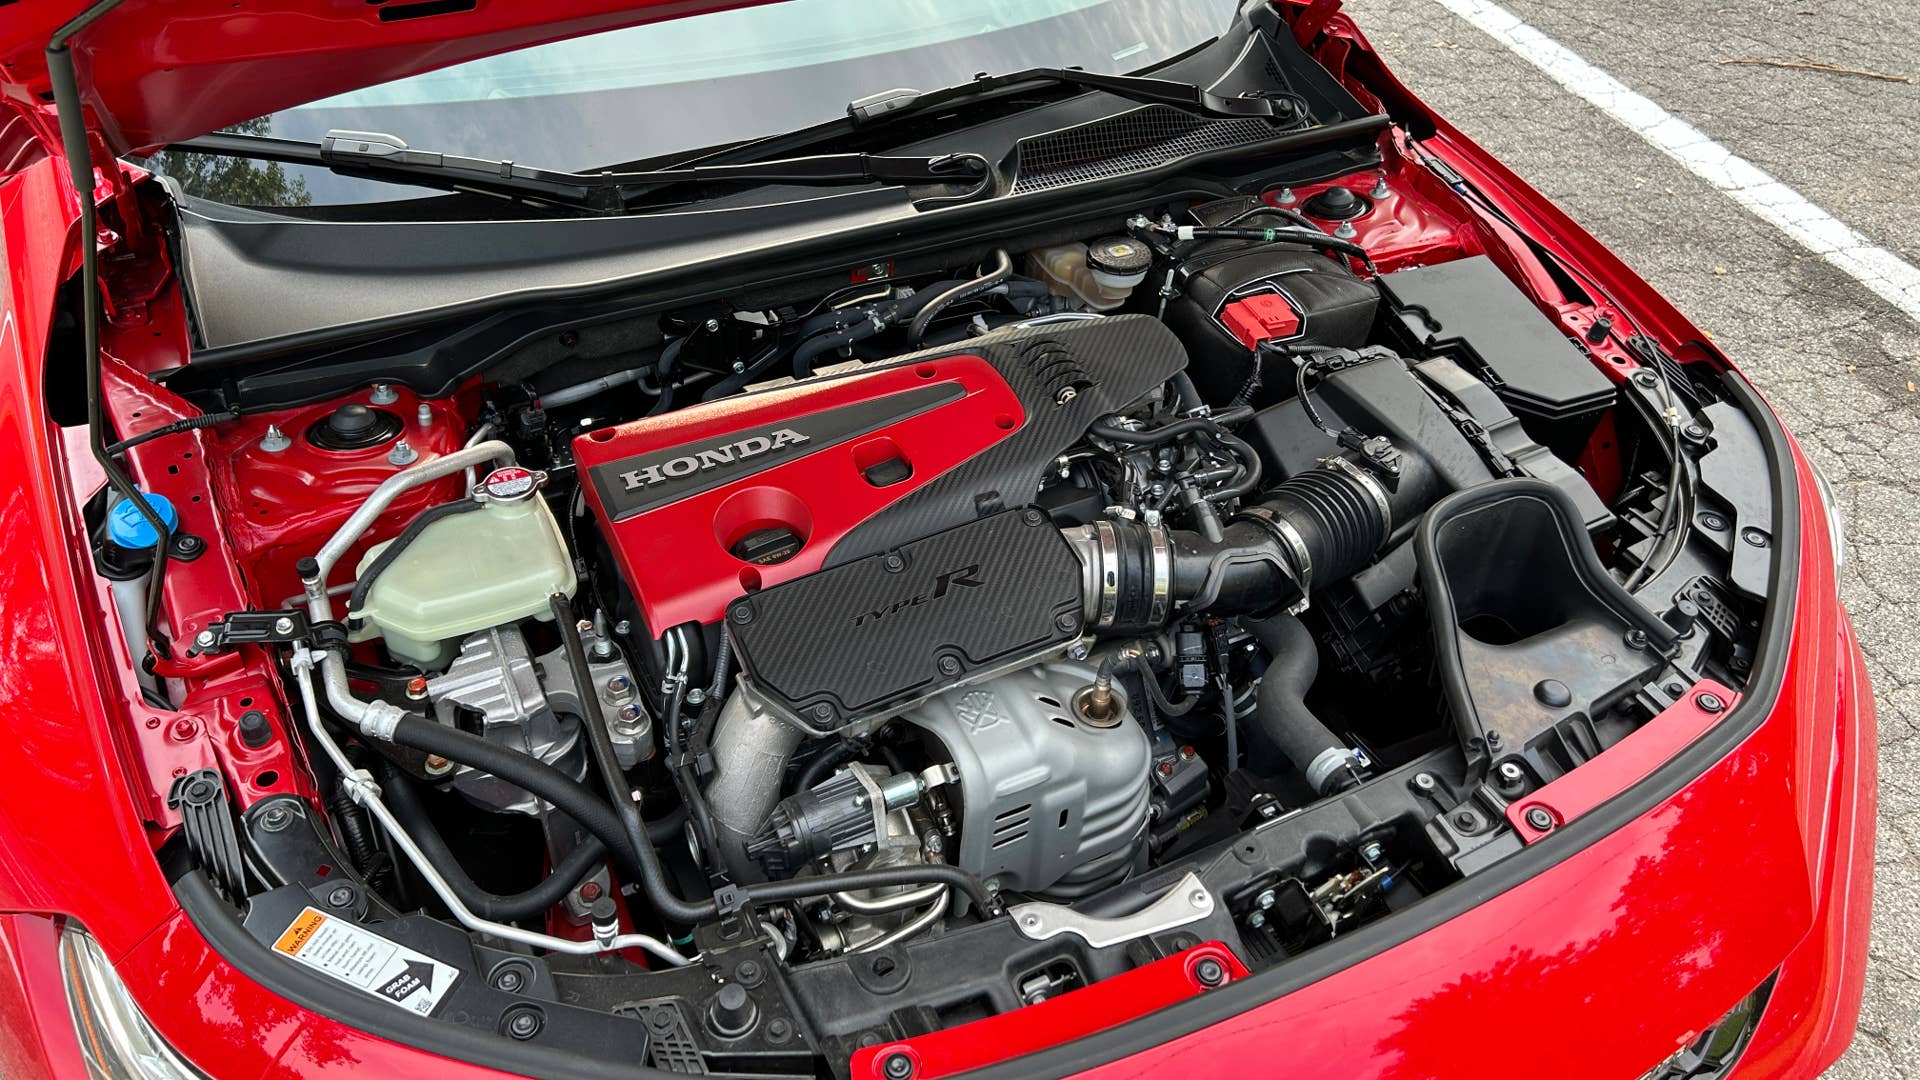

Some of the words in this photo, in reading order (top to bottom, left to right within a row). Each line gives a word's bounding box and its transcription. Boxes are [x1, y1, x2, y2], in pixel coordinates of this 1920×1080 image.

[619, 428, 811, 491] HONDA
[848, 594, 929, 627] TYPE
[933, 564, 985, 599] R
[287, 915, 322, 953] WARNING
[385, 973, 411, 994] GRAB
[394, 977, 421, 999] FOAM
